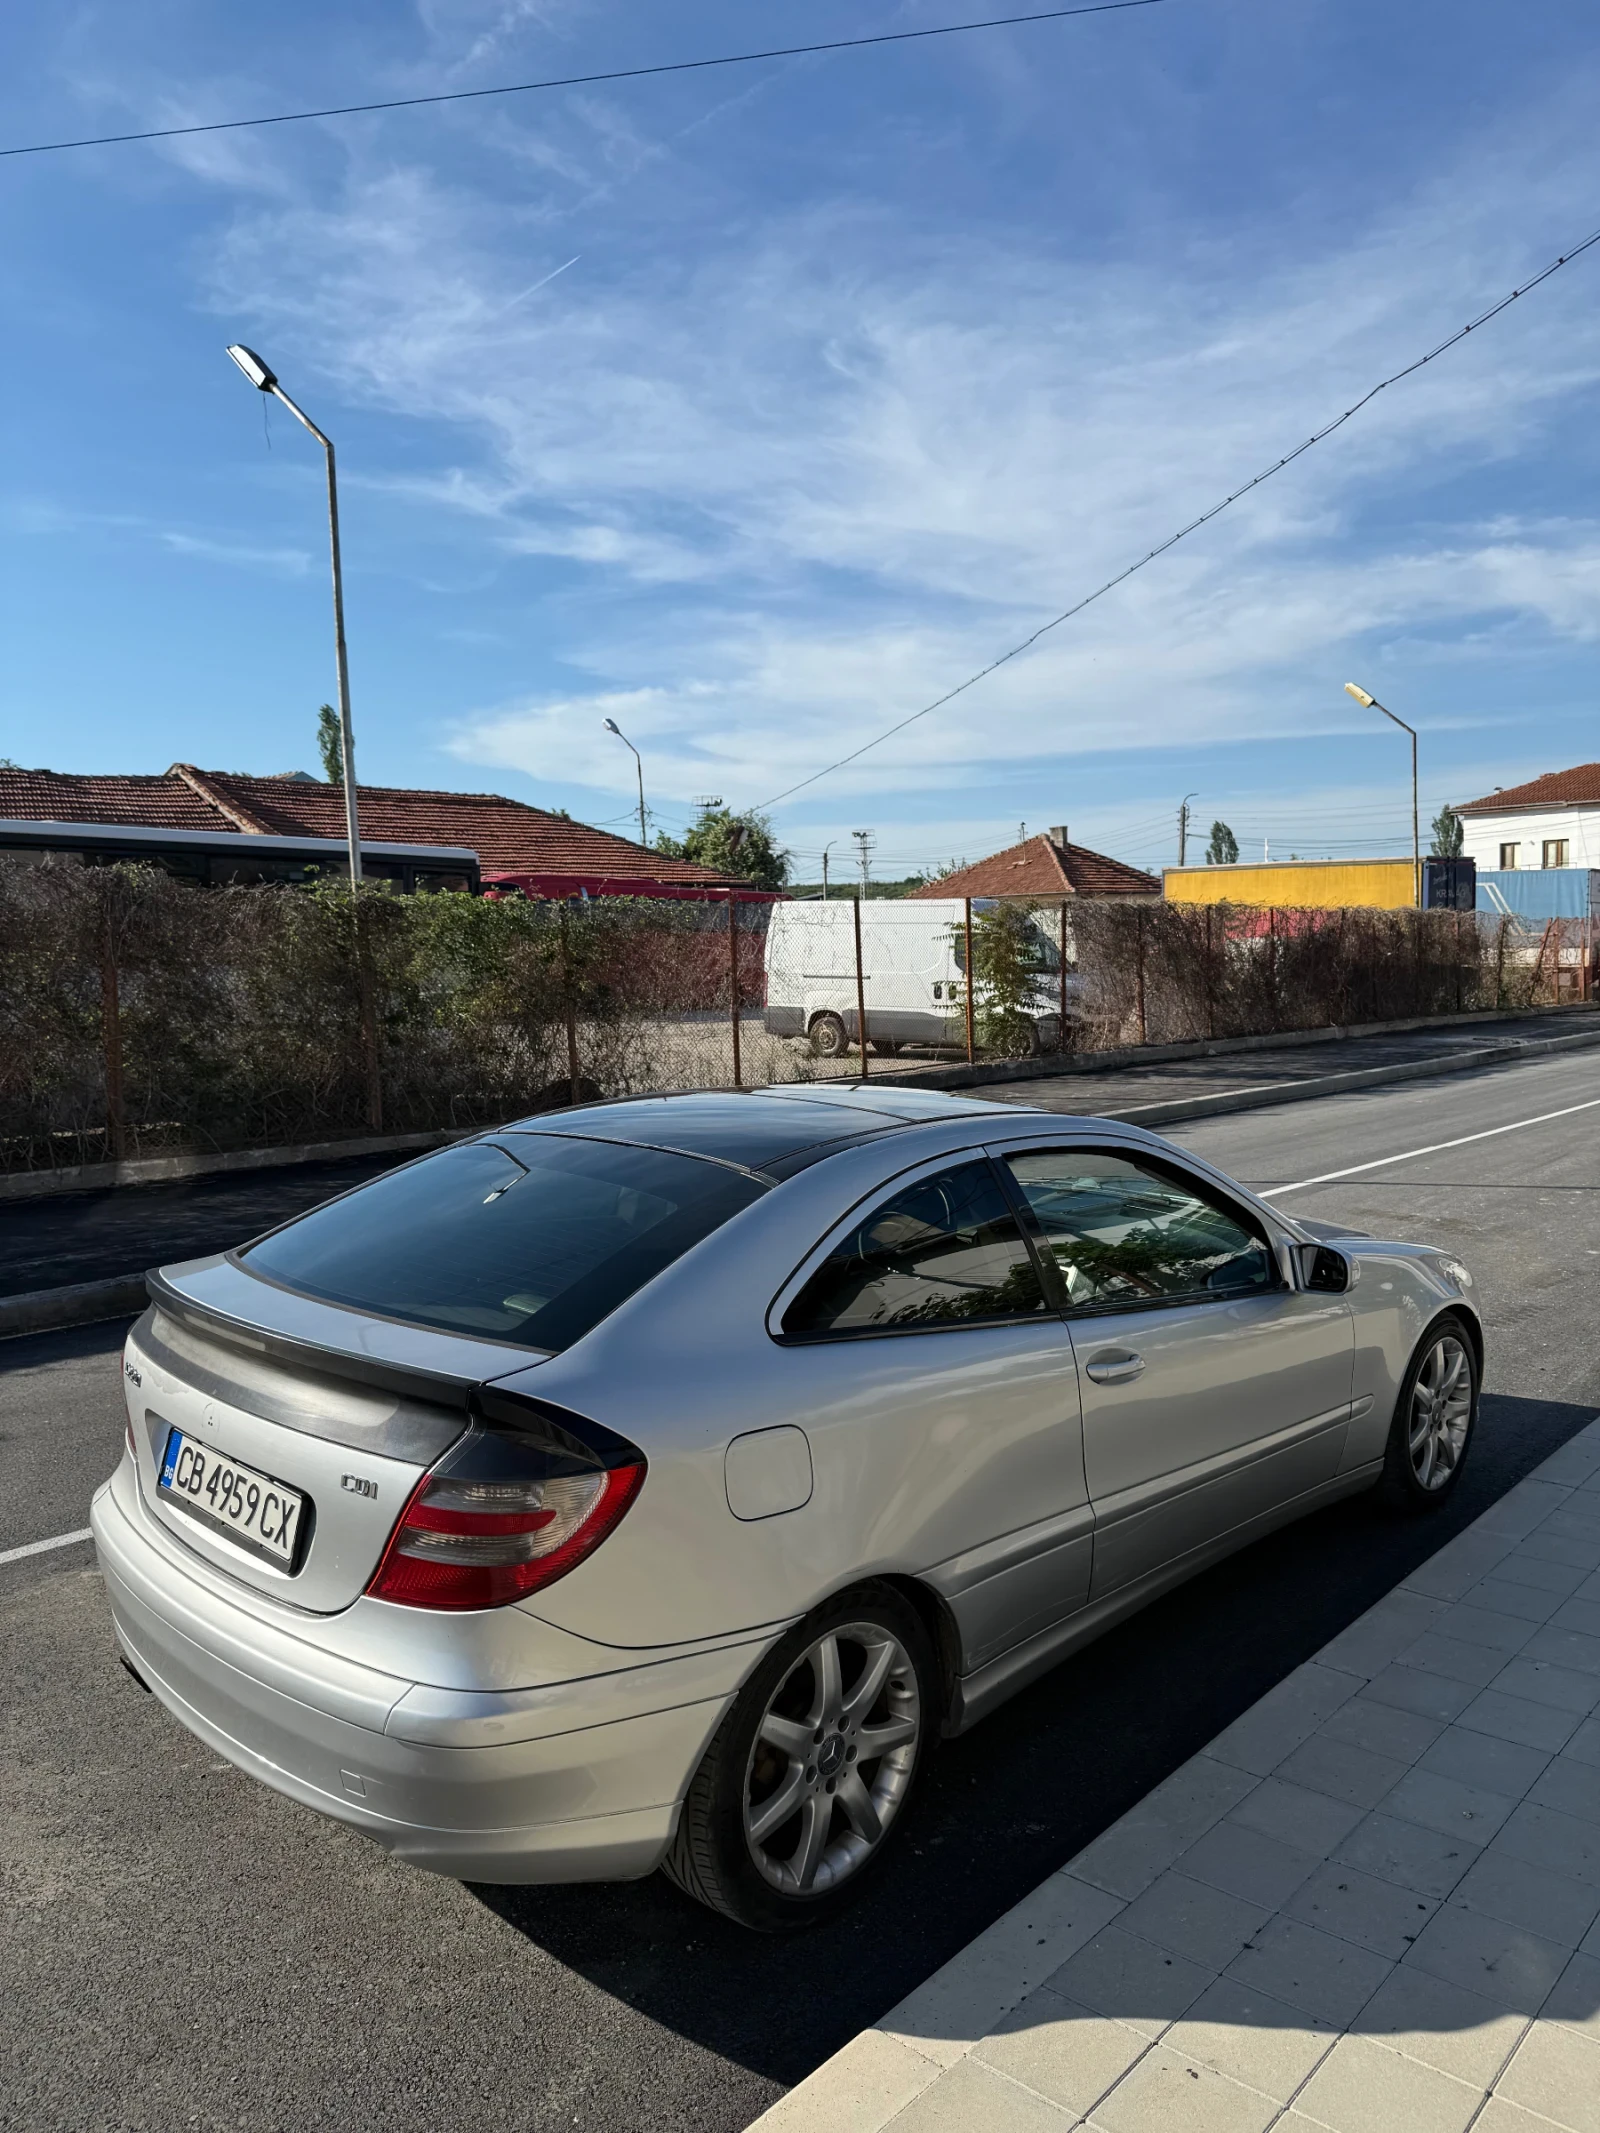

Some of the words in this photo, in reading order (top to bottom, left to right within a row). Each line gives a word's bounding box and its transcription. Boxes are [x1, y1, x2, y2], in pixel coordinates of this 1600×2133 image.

[164, 1464, 174, 1480] BG
[340, 1472, 379, 1500] CDI
[176, 1446, 205, 1495] CB
[205, 1463, 261, 1527] 4959
[259, 1491, 296, 1550] CX
